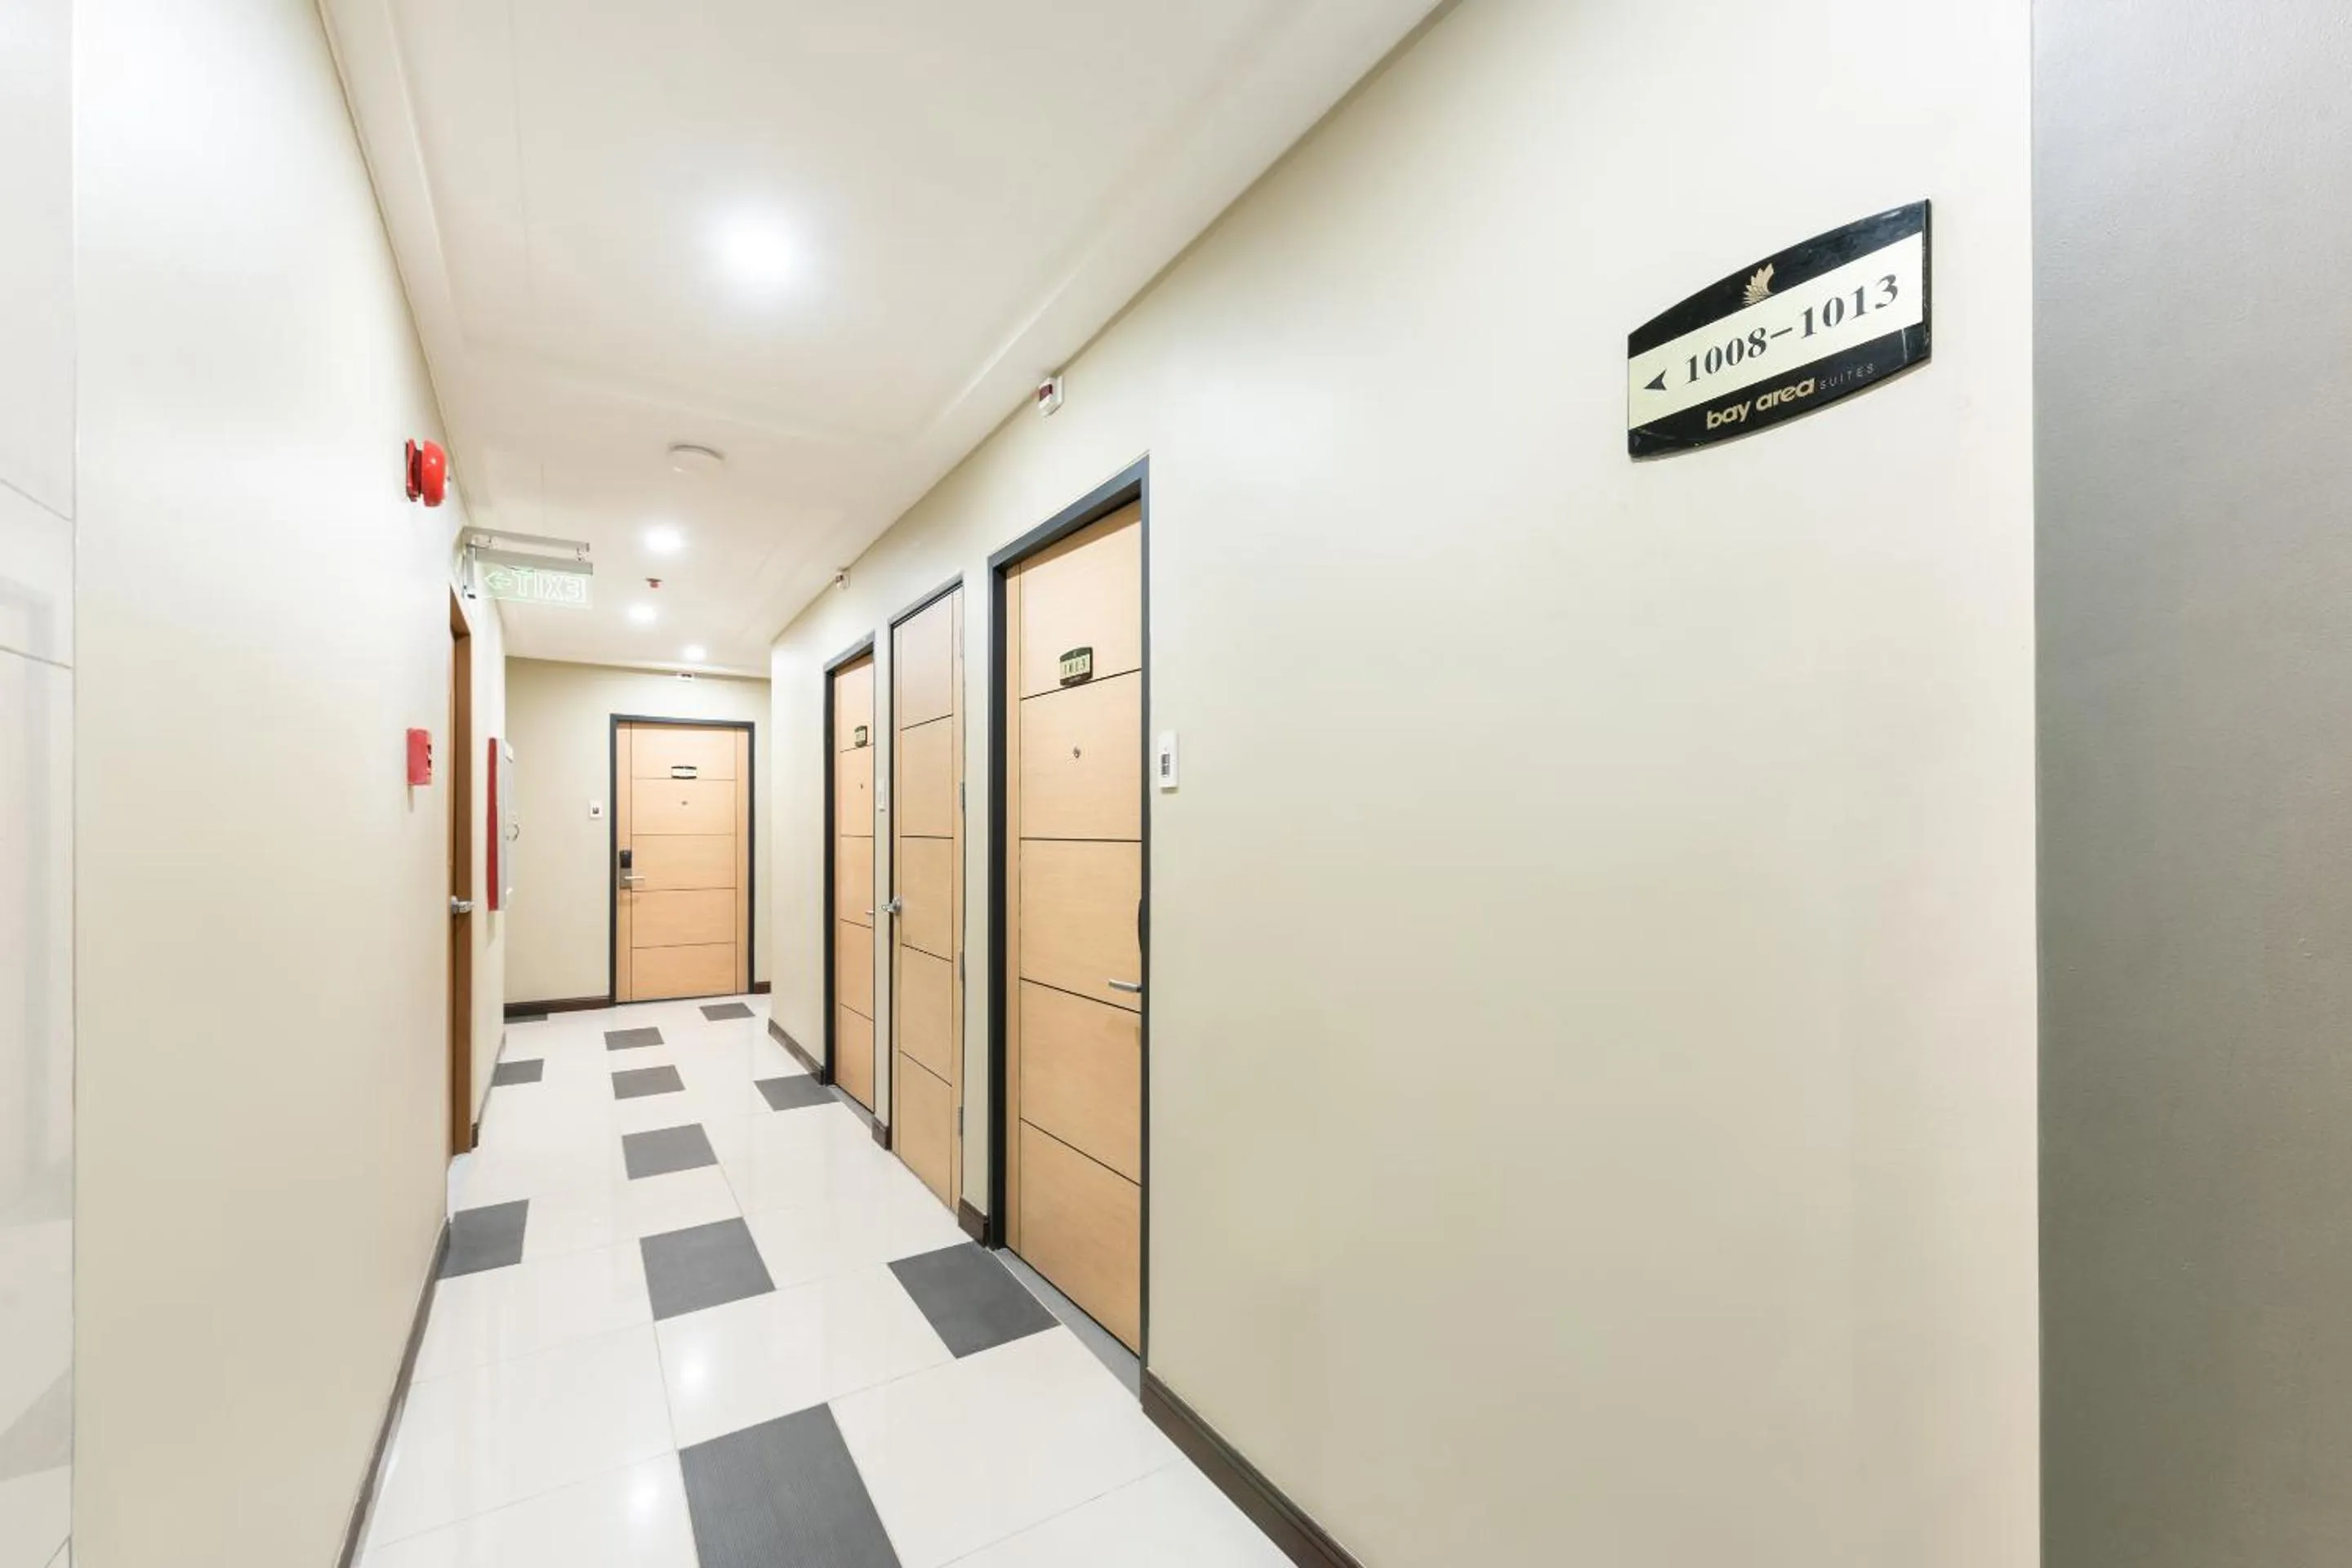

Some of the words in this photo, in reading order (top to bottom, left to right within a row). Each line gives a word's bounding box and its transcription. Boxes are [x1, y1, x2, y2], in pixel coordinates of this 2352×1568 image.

[1685, 274, 1899, 385] 1008-1013
[1706, 401, 1752, 430] bay
[1756, 377, 1816, 409] area
[1820, 363, 1874, 390] SUITES
